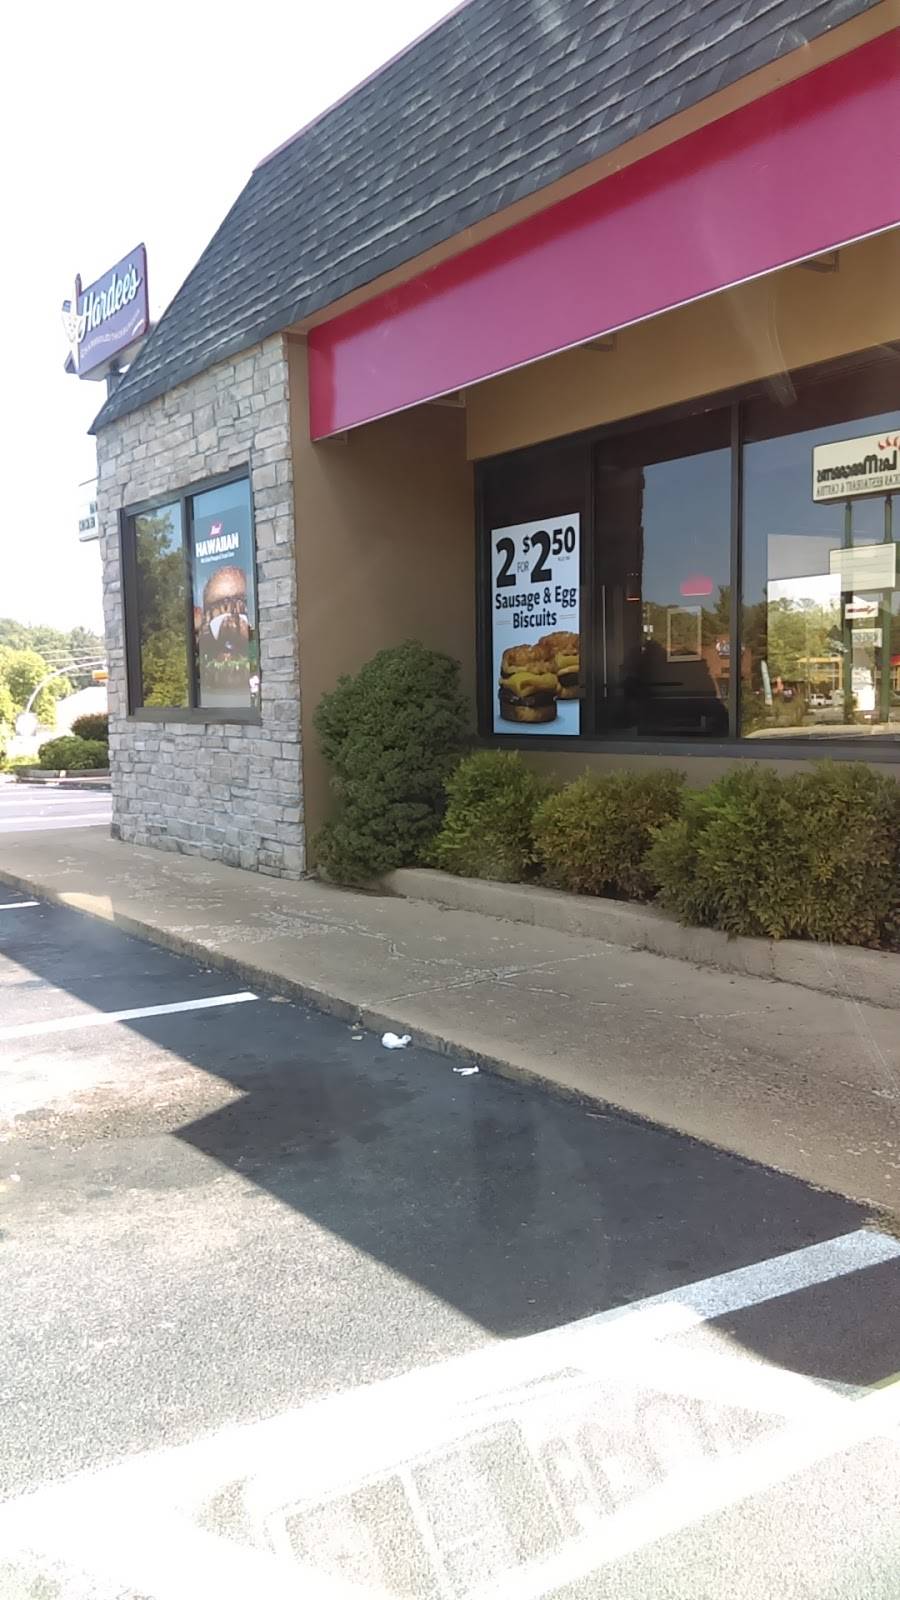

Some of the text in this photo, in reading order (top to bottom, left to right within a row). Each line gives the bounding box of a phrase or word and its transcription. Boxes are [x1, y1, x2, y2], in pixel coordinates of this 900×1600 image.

[78, 263, 142, 343] Hardee's
[195, 532, 239, 558] HAWAIIAN
[495, 537, 516, 588] 2
[517, 561, 529, 573] FOR
[495, 585, 577, 612] Sausage & Egg
[513, 608, 557, 629] Biscuits
